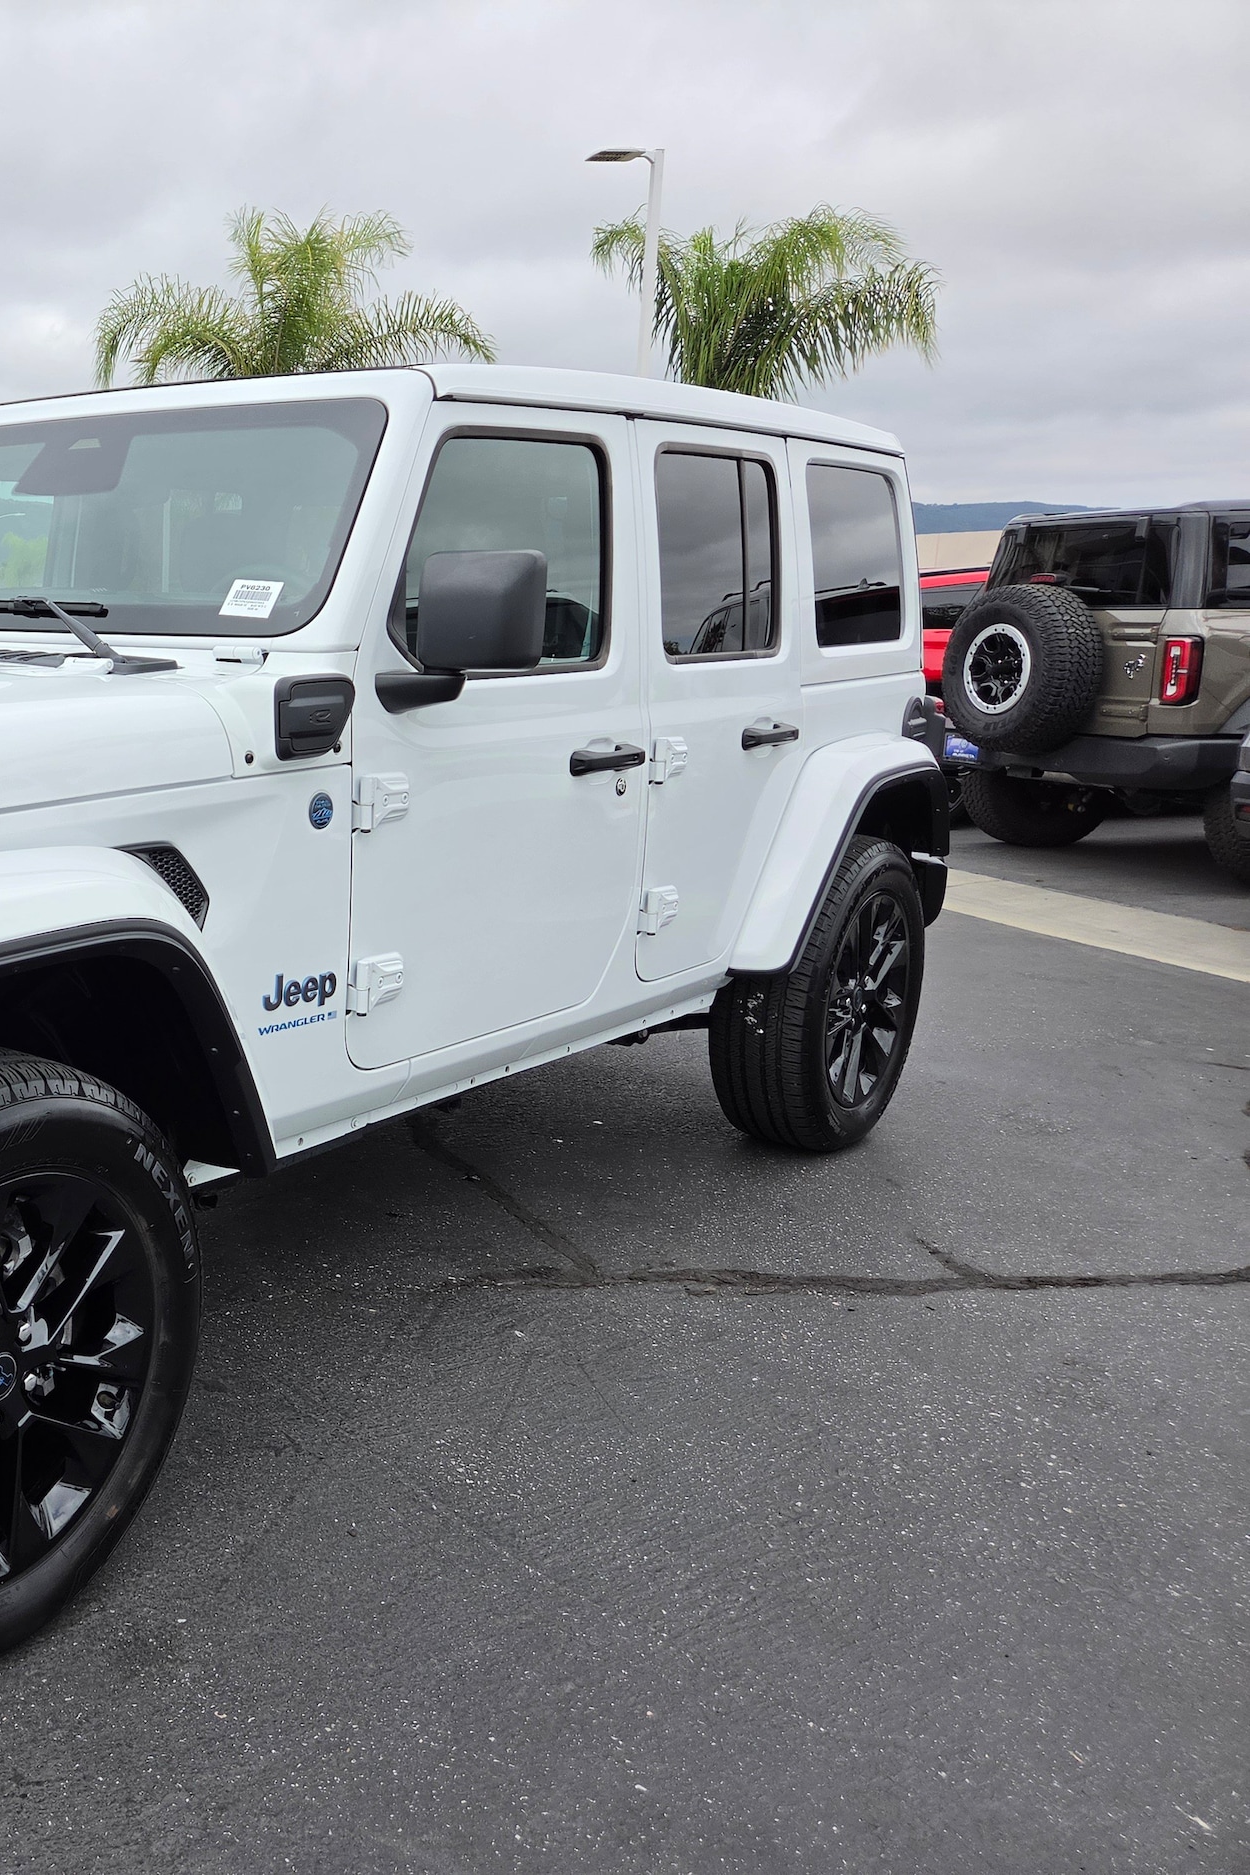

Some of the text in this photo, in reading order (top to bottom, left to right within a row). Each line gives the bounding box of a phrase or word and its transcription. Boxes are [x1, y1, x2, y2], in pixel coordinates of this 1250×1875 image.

[262, 971, 337, 1012] Jeep
[258, 1013, 325, 1036] WRANGLER
[133, 1142, 195, 1260] NEXEN
